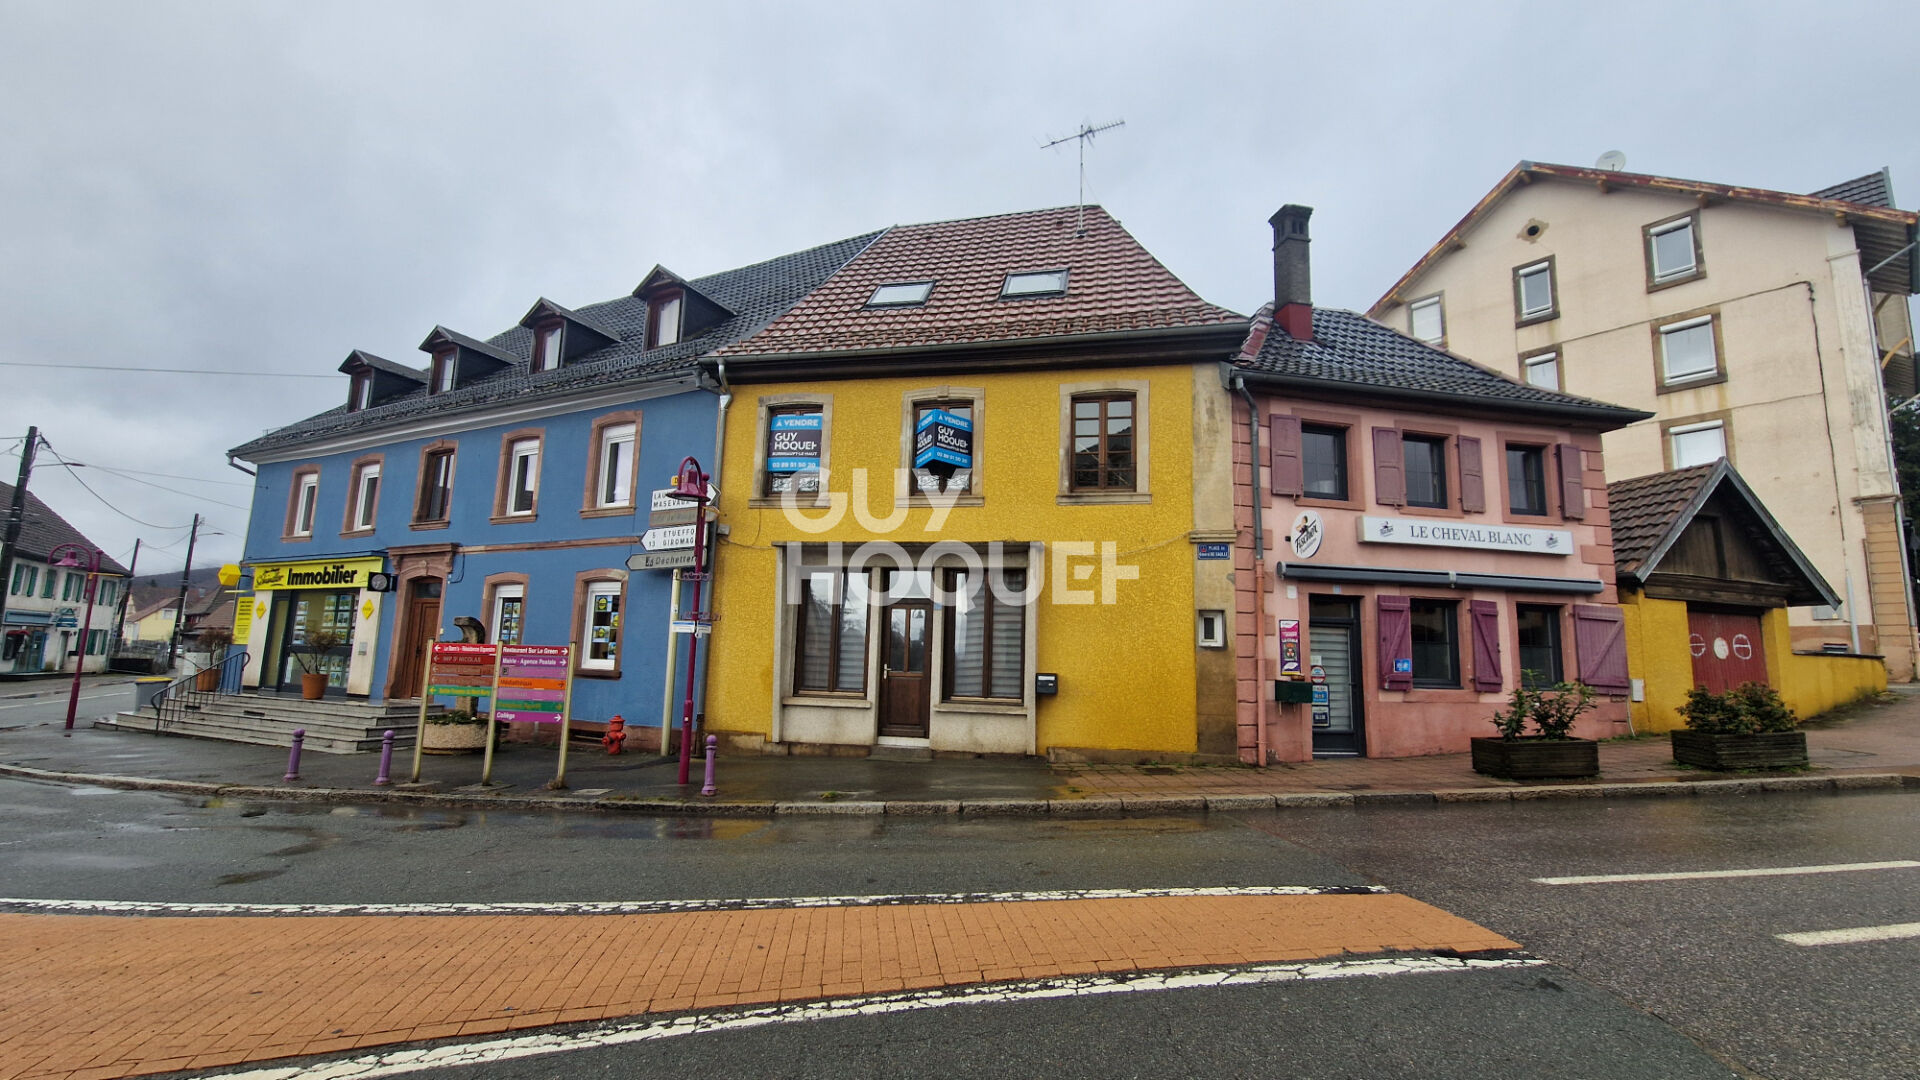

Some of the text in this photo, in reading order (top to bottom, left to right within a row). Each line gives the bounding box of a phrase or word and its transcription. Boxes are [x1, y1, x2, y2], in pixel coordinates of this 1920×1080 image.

[945, 415, 968, 428] VENDRE
[774, 432, 797, 441] GUY
[938, 426, 954, 436] GUY
[774, 441, 817, 450] HOQUET
[938, 434, 968, 448] HOQUET
[663, 537, 694, 545] GIROMAG
[1410, 525, 1533, 546] LE CHEVAL BLANC
[287, 564, 358, 585] Immobilier
